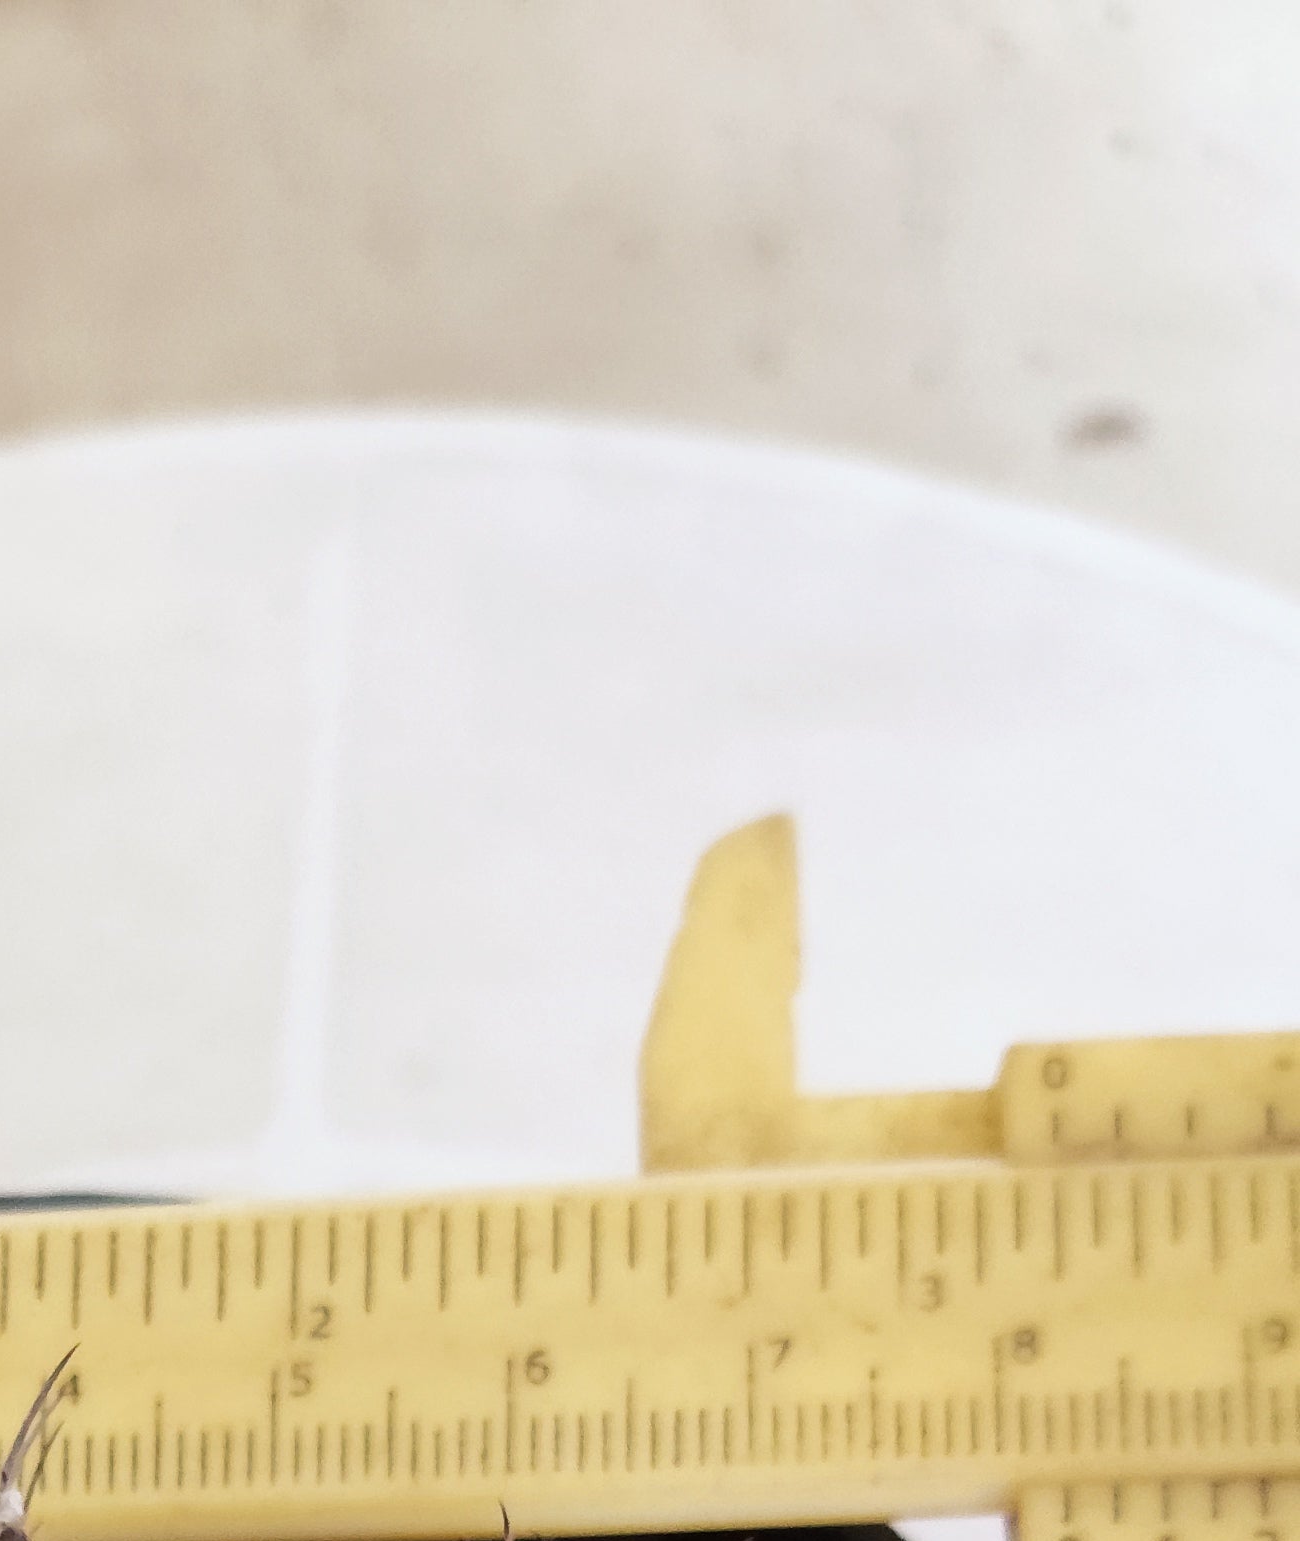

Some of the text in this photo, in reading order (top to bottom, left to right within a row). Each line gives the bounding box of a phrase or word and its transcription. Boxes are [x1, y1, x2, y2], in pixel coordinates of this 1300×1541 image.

[1041, 1057, 1068, 1090] 0
[308, 1304, 333, 1339] 2
[919, 1273, 946, 1310] 3
[289, 1361, 313, 1397] 5
[523, 1350, 550, 1386] 6
[770, 1337, 792, 1368] 7
[1013, 1326, 1040, 1362] 8
[1262, 1317, 1288, 1352] 9
